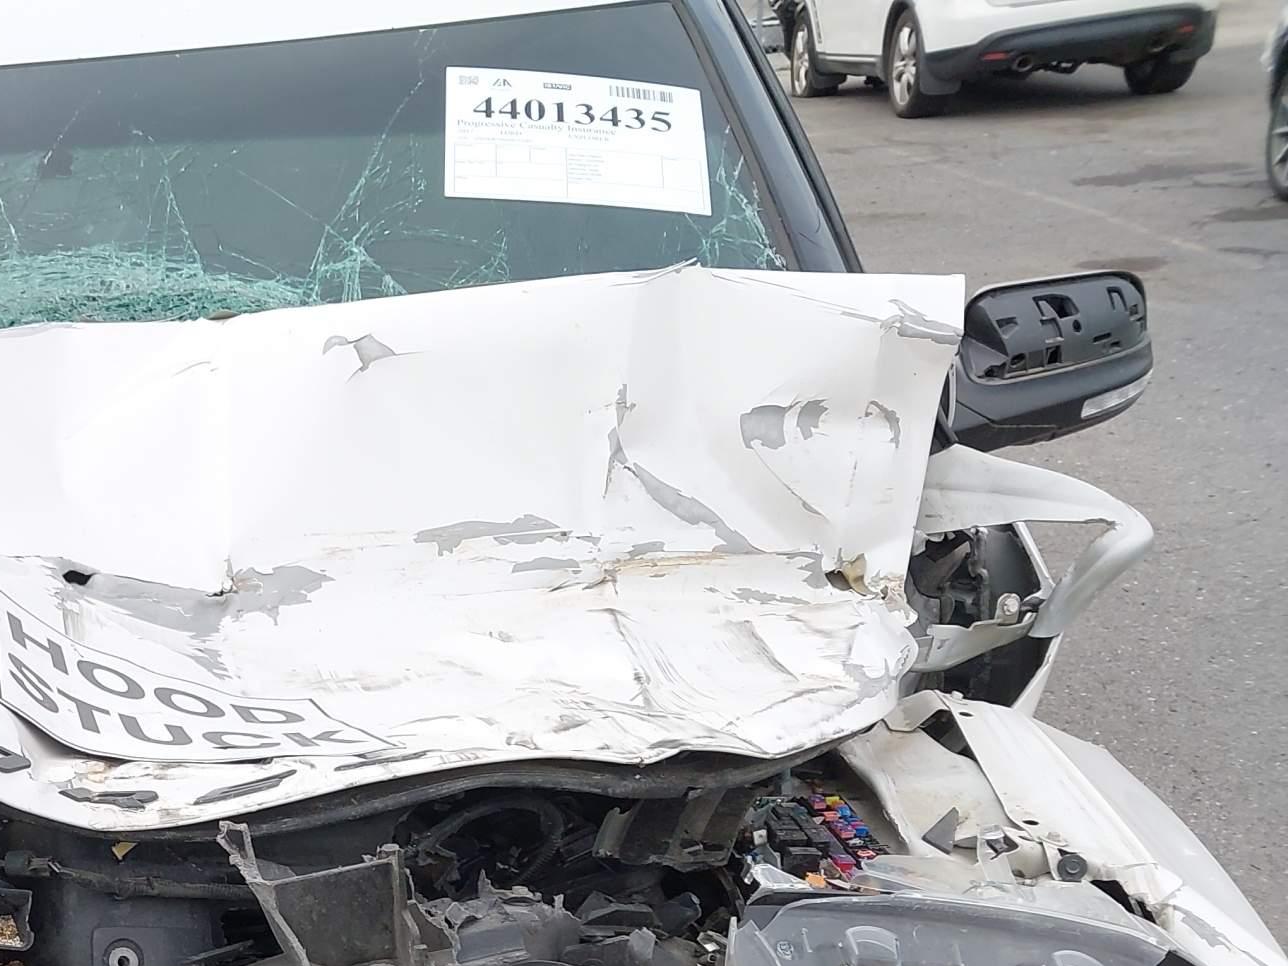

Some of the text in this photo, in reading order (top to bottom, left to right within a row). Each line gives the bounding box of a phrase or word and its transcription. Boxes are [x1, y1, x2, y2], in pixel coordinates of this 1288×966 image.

[472, 96, 673, 133] 44013435
[6, 610, 306, 725] HOOD
[7, 651, 370, 750] STUCK
